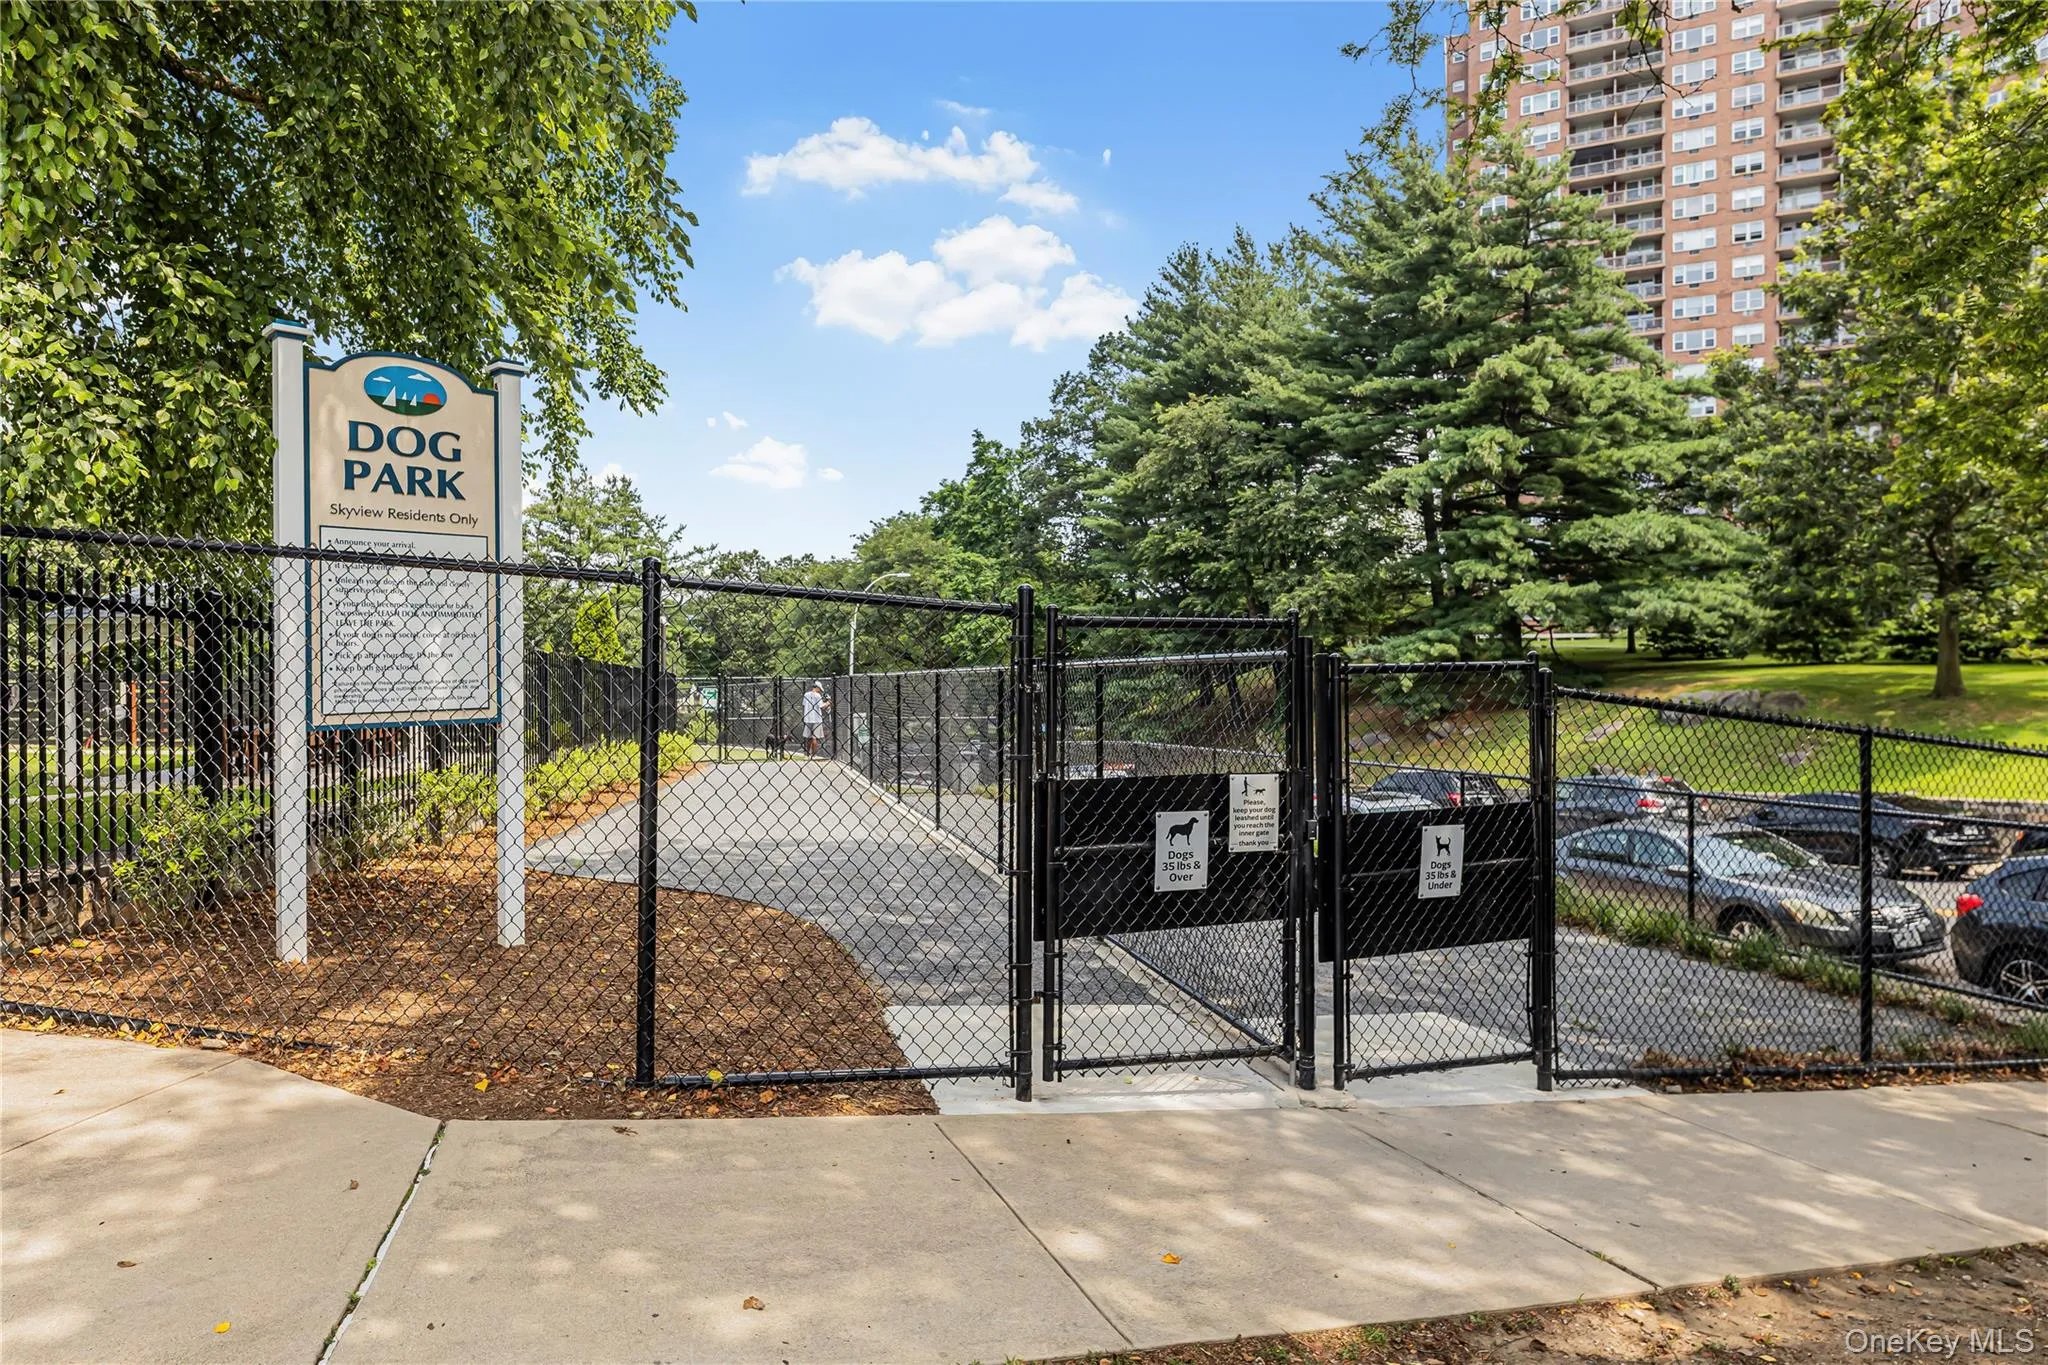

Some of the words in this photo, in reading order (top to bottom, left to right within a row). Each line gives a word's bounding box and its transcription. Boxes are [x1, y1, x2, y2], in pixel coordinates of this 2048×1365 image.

[348, 420, 462, 462] DOG
[343, 459, 466, 500] PARK
[330, 503, 384, 520] Skyview
[388, 508, 446, 523] Residents
[449, 513, 479, 529] Only
[334, 537, 372, 547] Announce
[373, 541, 390, 549] your
[391, 541, 416, 550] arrival.
[399, 630, 420, 639] socl,
[1233, 806, 1248, 815] keep
[1248, 807, 1263, 815] your
[1264, 806, 1276, 815] dog
[1260, 813, 1275, 821] until
[1233, 822, 1246, 830] you
[1246, 821, 1264, 829] reach
[1238, 829, 1255, 837] inner
[1255, 830, 1270, 838] gate
[1168, 850, 1194, 862] Dogs
[1162, 862, 1175, 872] 35
[1177, 861, 1192, 871] lbs
[1193, 860, 1202, 870] &
[1430, 861, 1452, 871] Dogs
[1169, 872, 1194, 882] Over
[1425, 871, 1436, 880] 35
[1437, 870, 1449, 880] lbs
[1450, 869, 1457, 879] &
[1427, 880, 1453, 891] Under
